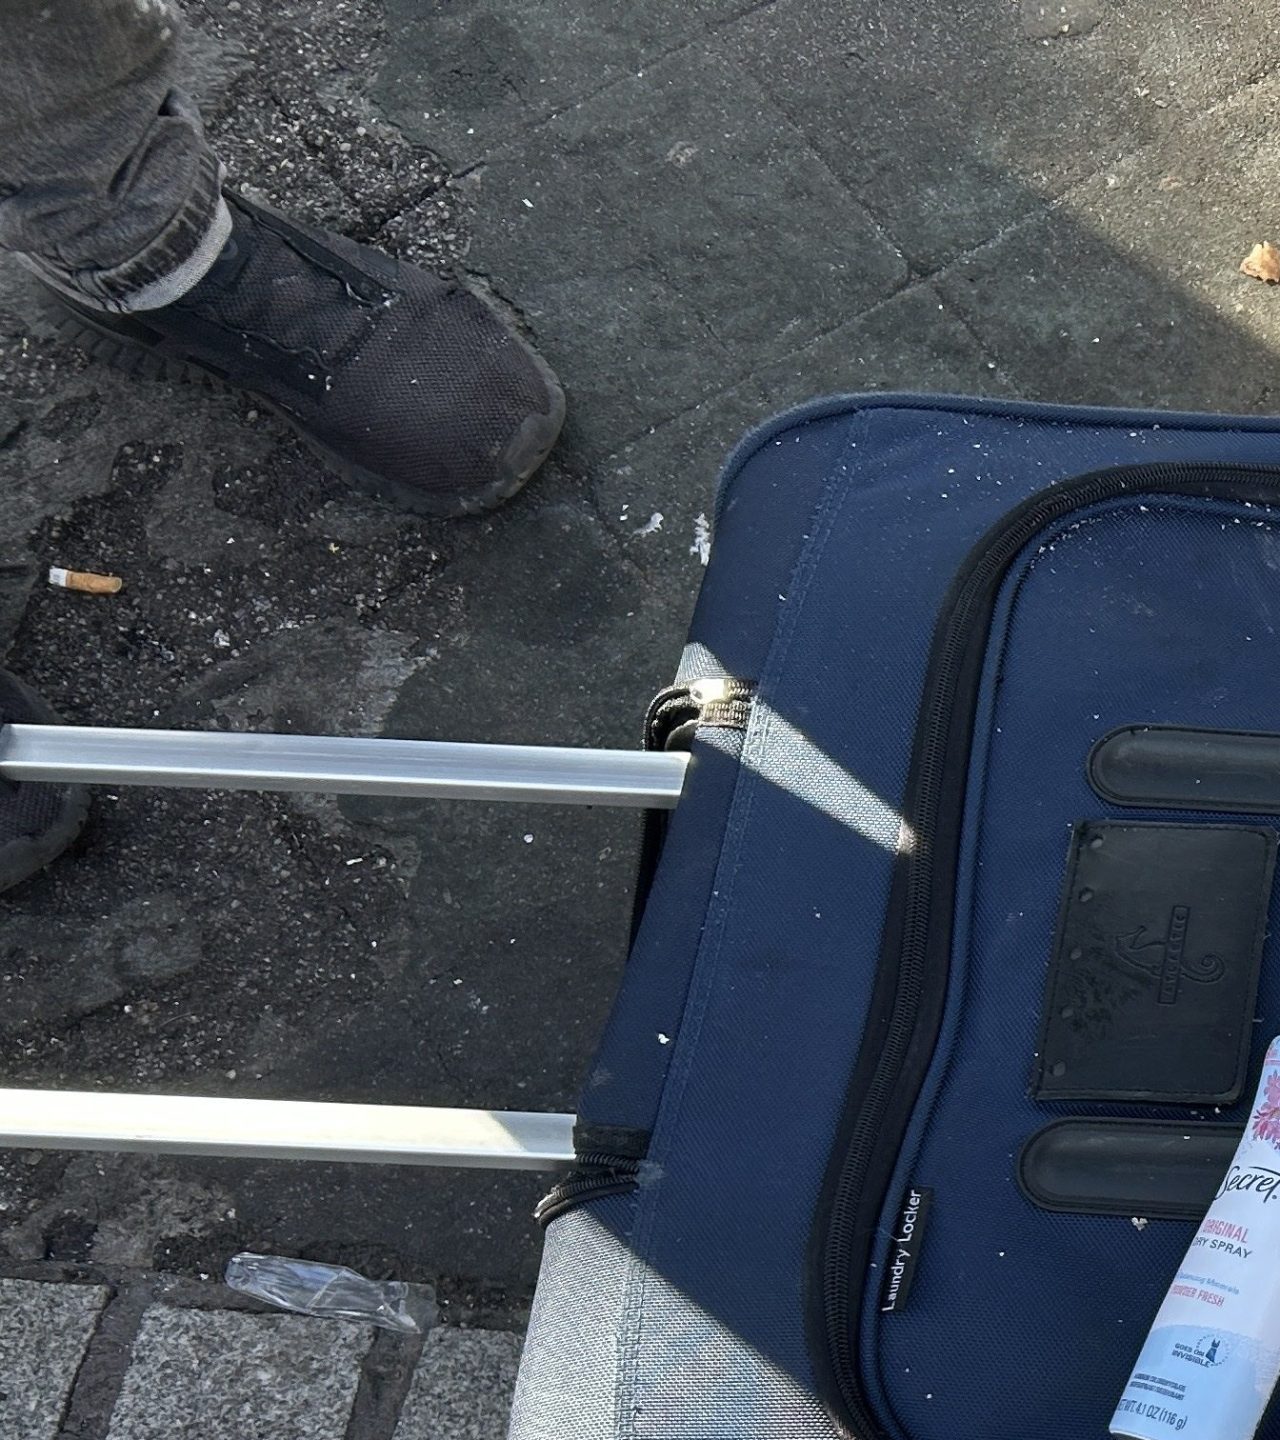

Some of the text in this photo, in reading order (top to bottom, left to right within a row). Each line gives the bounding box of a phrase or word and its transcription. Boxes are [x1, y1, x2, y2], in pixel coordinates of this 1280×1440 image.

[882, 1190, 921, 1311] Laundry Locker
[1210, 1239, 1252, 1259] SPRAY
[1198, 1289, 1225, 1307] FRESH
[1174, 1342, 1192, 1353] GOES
[1171, 1350, 1210, 1368] INVISIBLE
[1147, 1403, 1158, 1419] OZ
[1159, 1407, 1177, 1425] (116
[1177, 1415, 1188, 1430] g)
